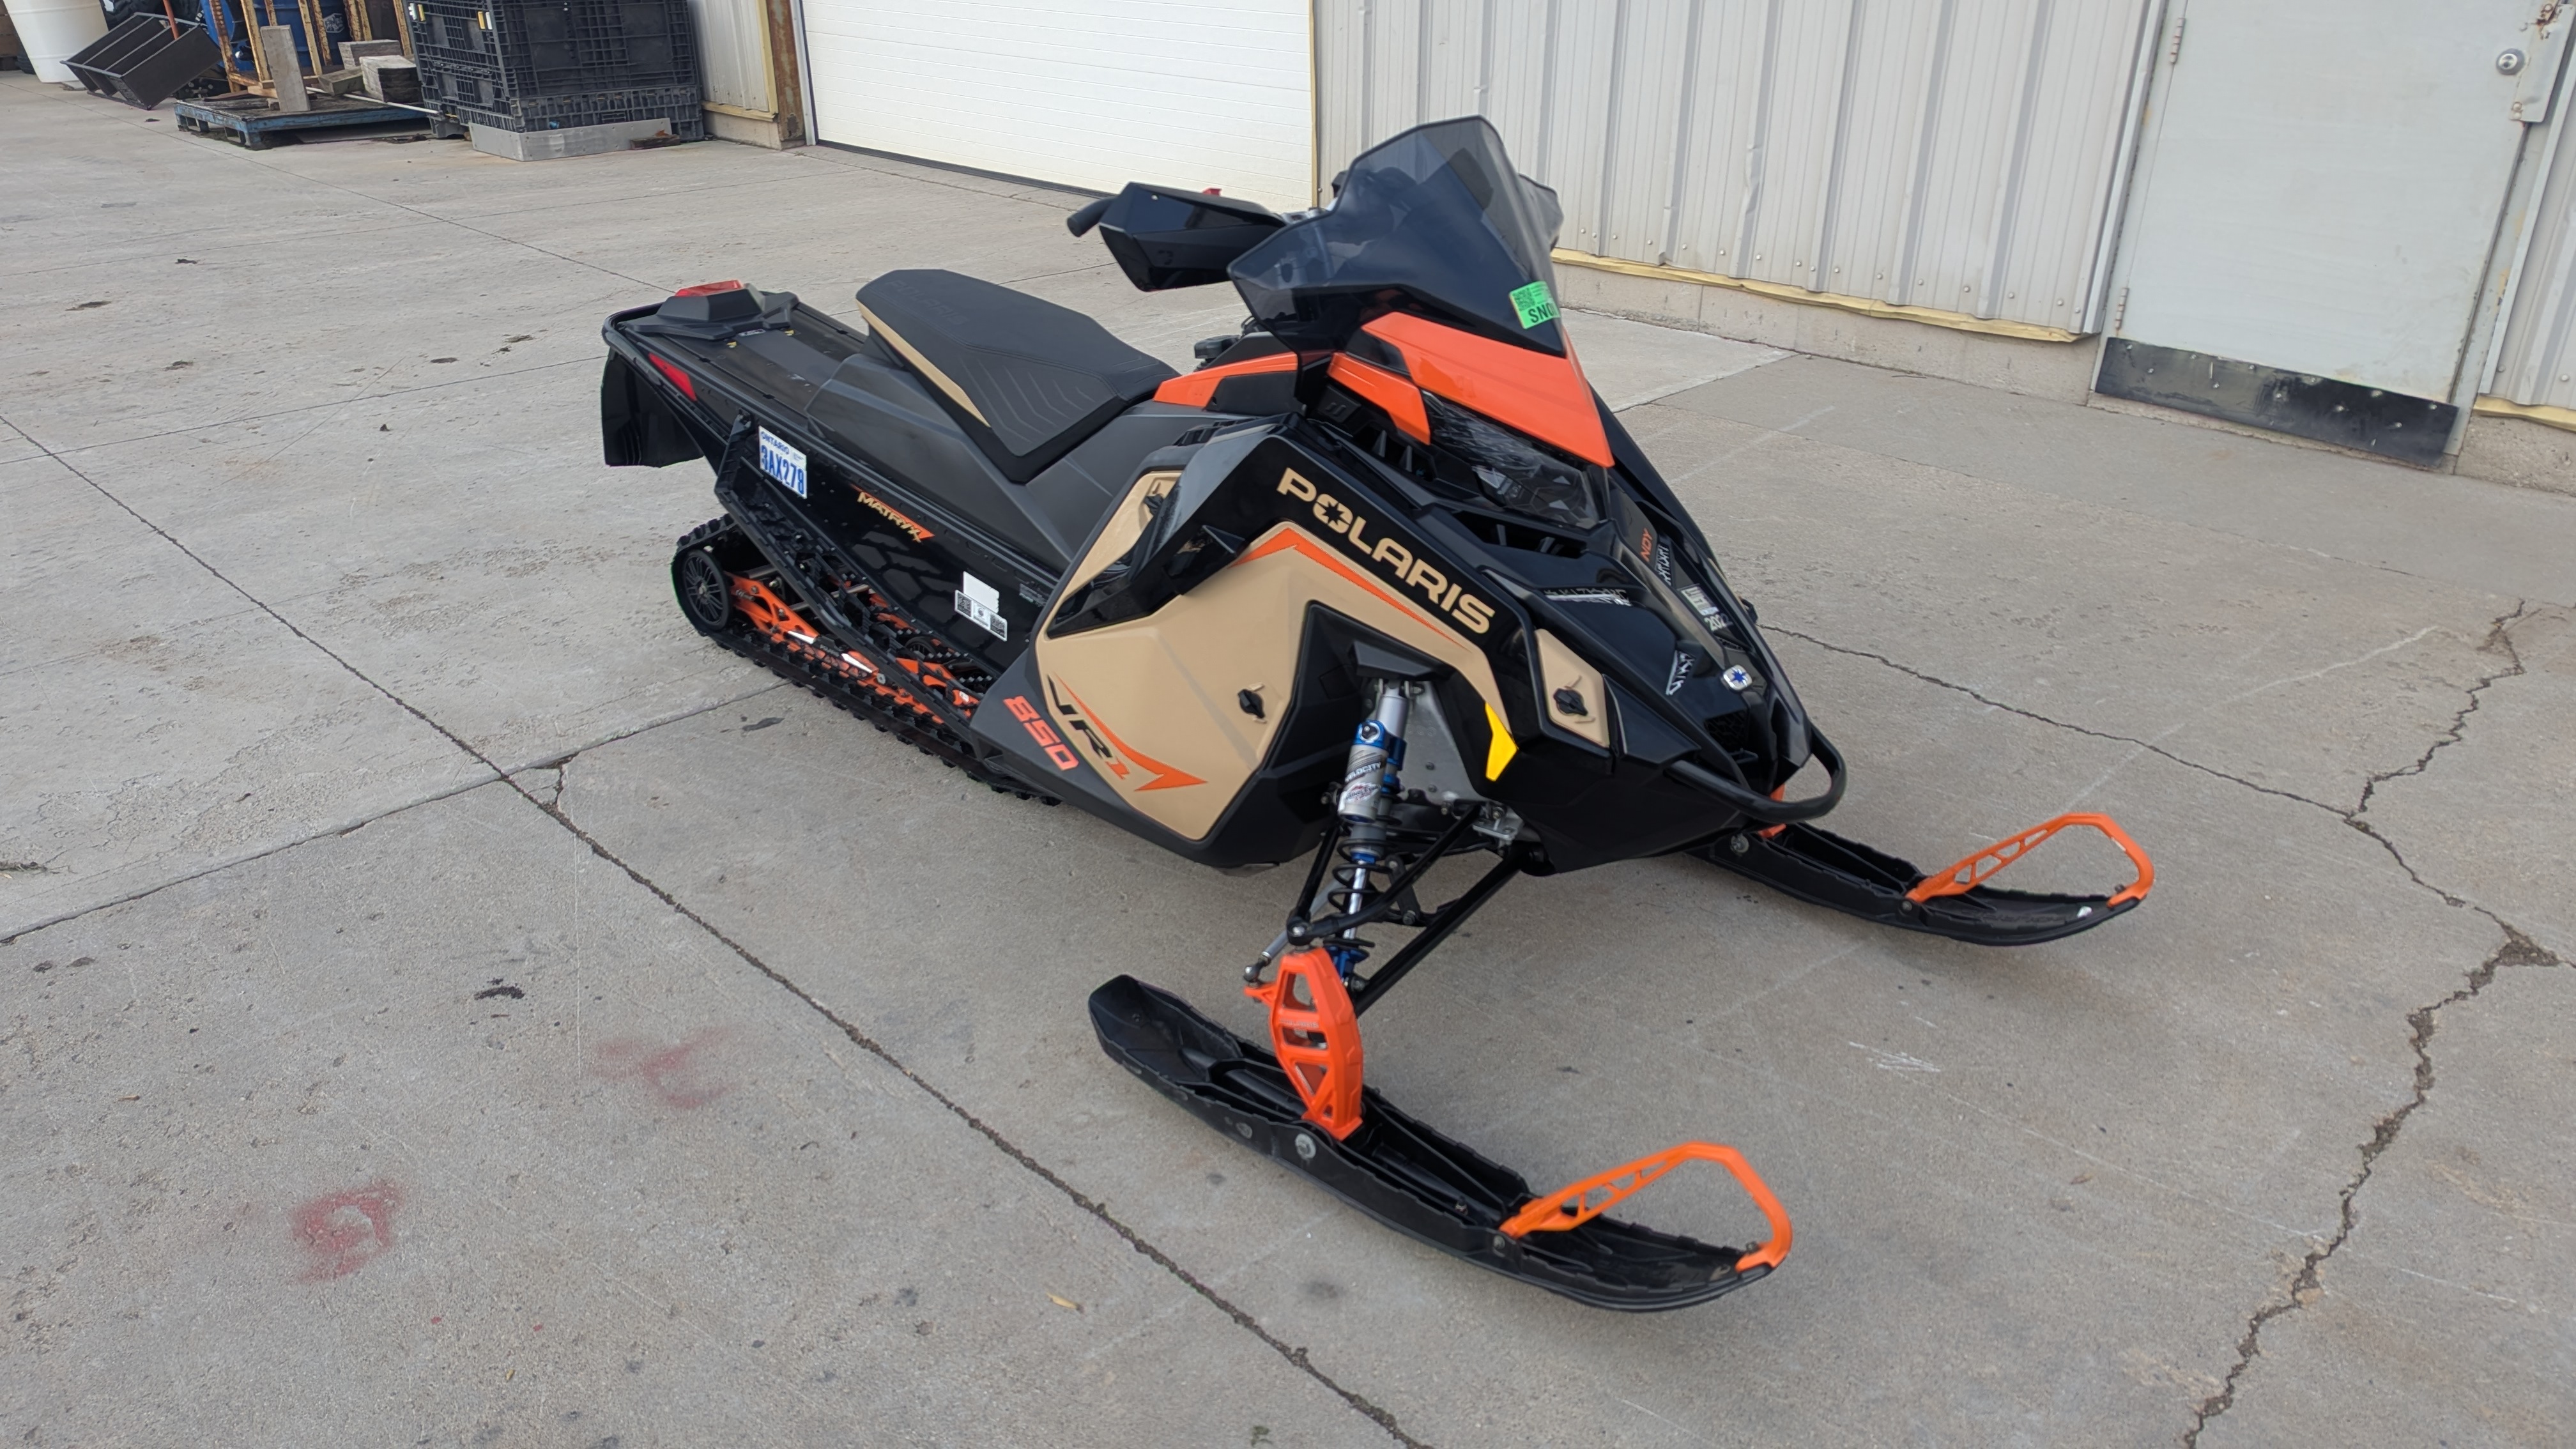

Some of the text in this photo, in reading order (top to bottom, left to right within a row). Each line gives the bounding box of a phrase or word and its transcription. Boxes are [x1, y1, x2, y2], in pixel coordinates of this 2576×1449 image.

[857, 491, 923, 544] MATRYX
[1640, 527, 1653, 562] NDY
[1276, 466, 1496, 634] POLARIS
[1002, 695, 1080, 771] 850
